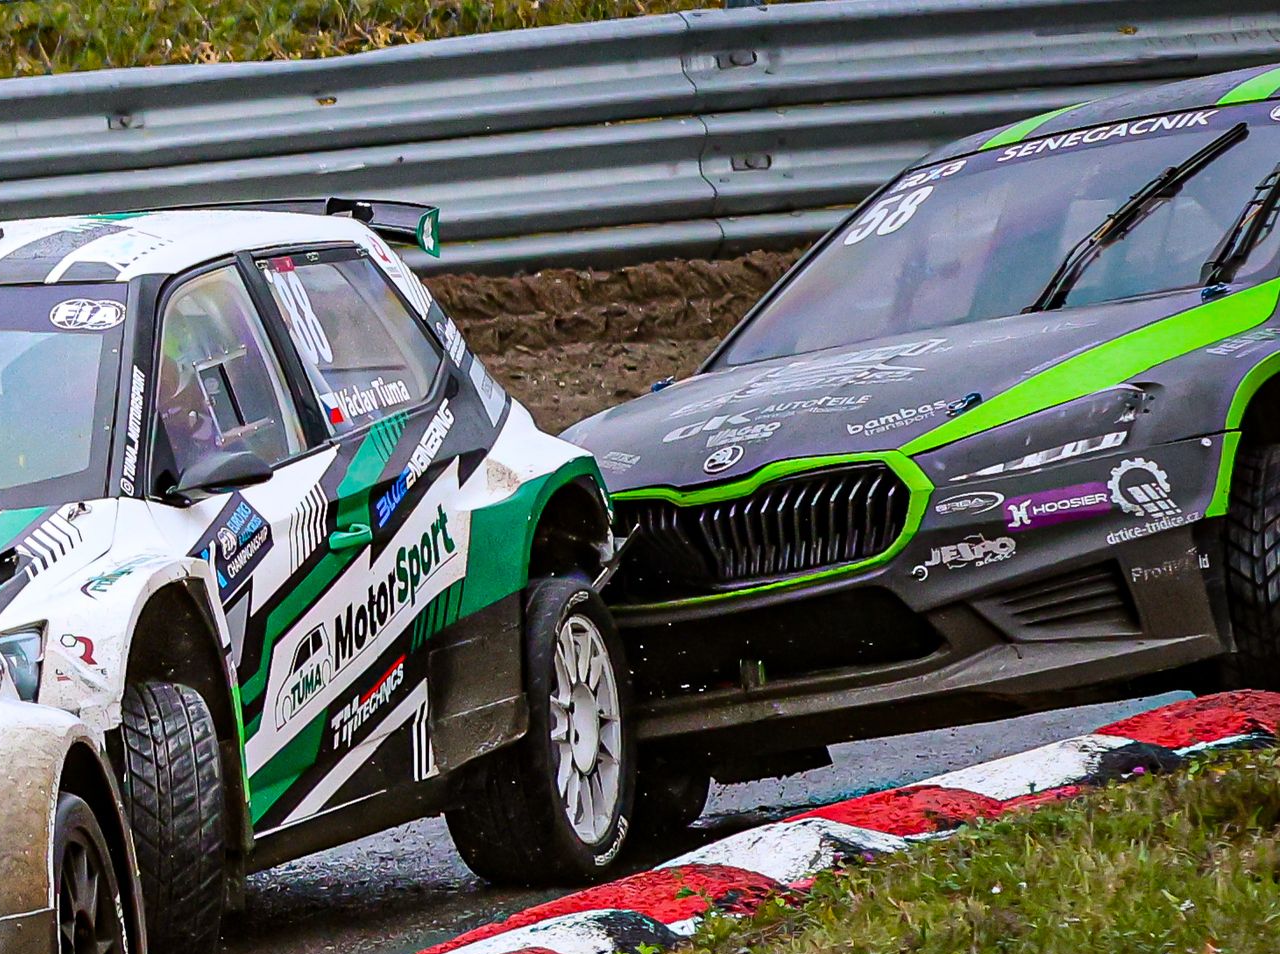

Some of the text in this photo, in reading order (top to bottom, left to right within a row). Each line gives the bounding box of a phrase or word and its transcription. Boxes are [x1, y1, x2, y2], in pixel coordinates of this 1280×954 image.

[997, 110, 1219, 162] SENEGACNIK
[844, 185, 933, 246] 58
[1033, 492, 1108, 515] HOOSIER
